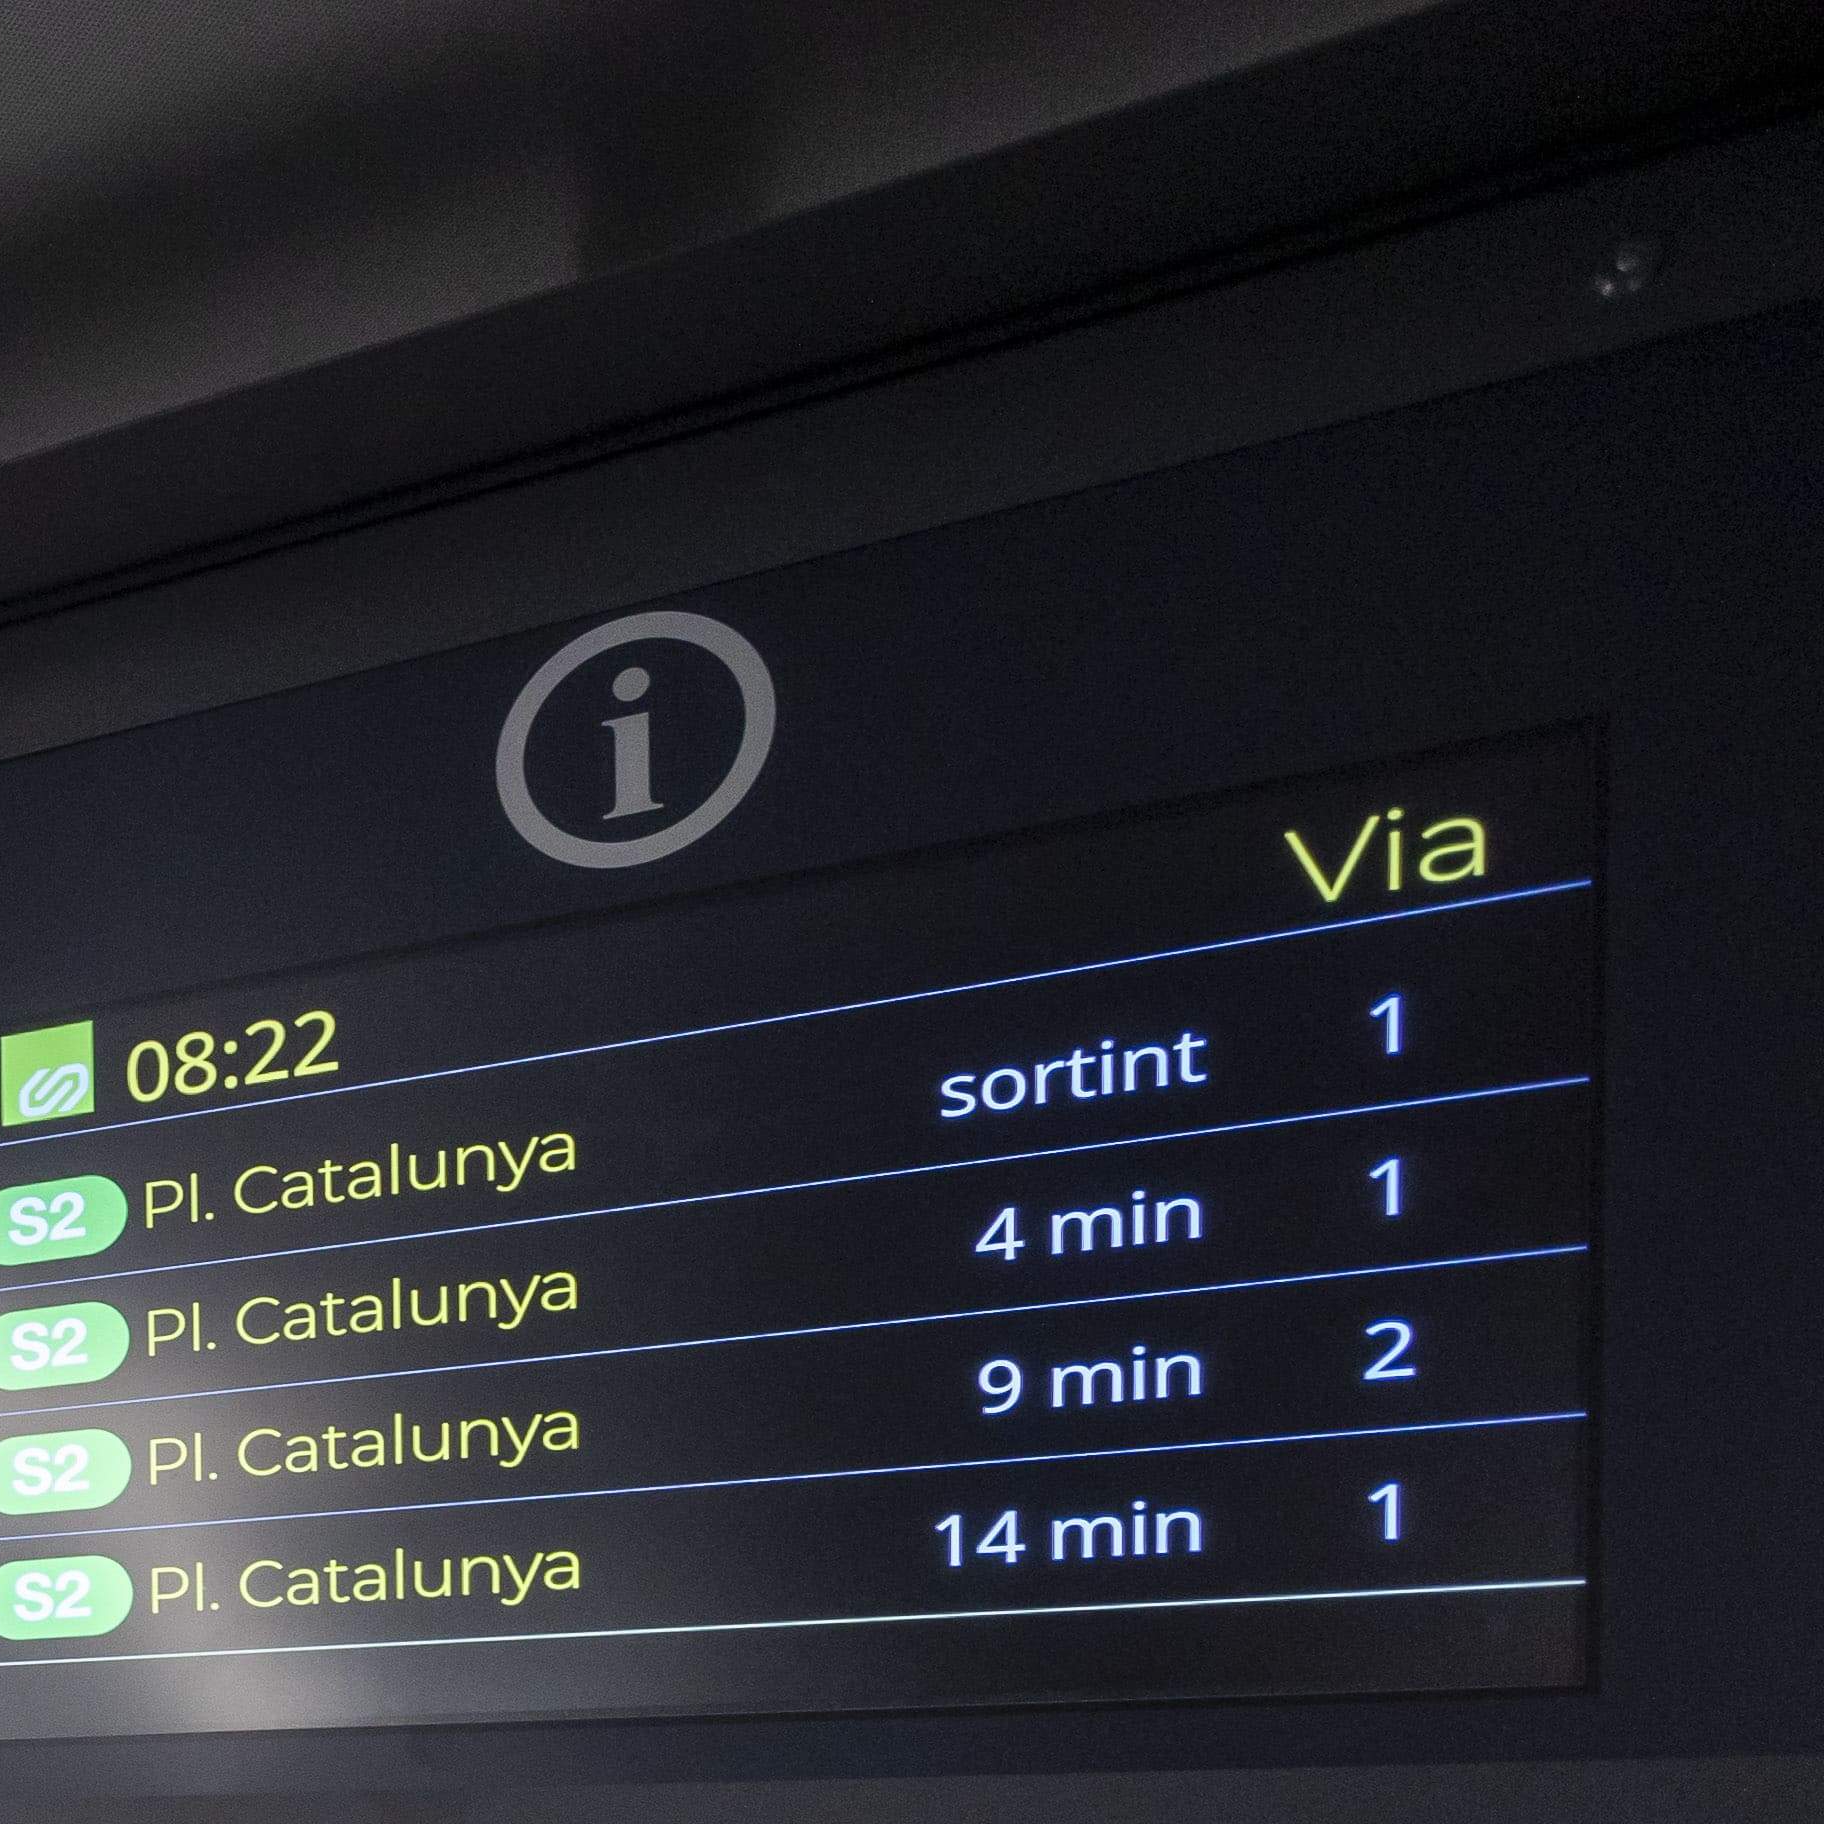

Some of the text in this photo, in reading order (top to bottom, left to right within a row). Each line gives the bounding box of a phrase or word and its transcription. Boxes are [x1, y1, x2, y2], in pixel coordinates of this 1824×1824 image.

[1284, 808, 1485, 903] Via
[8, 992, 1404, 1246] S2 Pl. Catalunya sortint 1
[126, 1010, 339, 1103] 08:22
[10, 1155, 1403, 1372] S2 Pl. Catalunya 4 min 1
[12, 1317, 1417, 1497] S2 Pl. Catalunya 9 min 2
[13, 1479, 1402, 1623] S2 Pl. Catalunya 14 min 1
